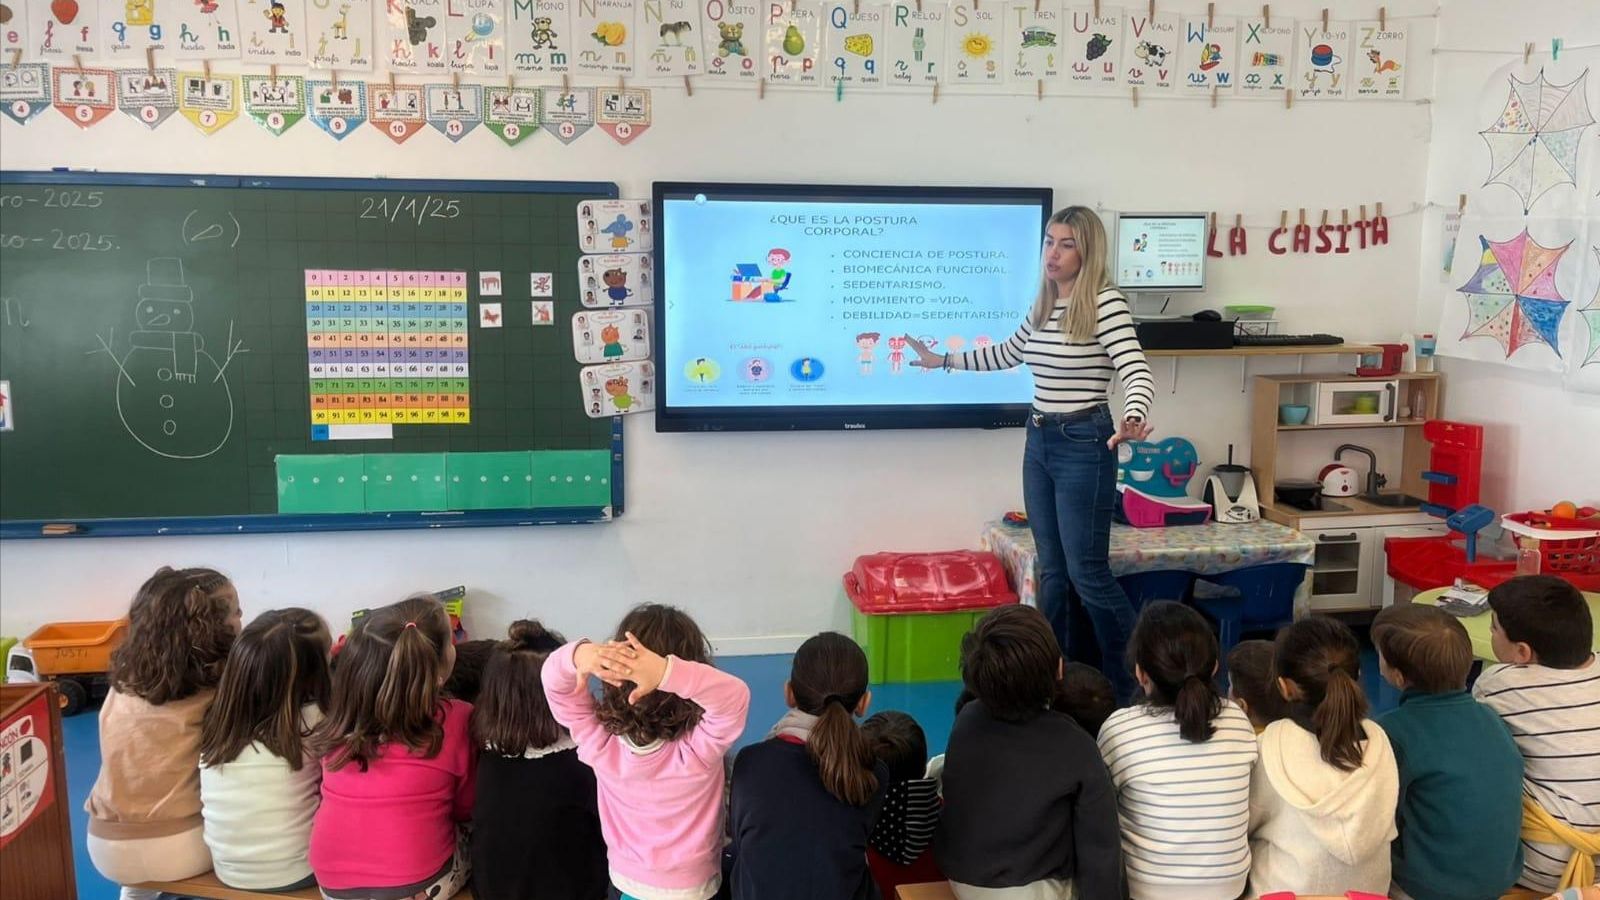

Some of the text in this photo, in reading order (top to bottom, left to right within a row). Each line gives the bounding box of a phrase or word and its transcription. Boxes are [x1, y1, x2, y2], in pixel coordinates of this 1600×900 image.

[448, 0, 494, 16] L LUPA
[514, 0, 564, 20] M MONO
[578, 0, 596, 18] N
[706, 0, 755, 20] O OSITO
[770, 3, 815, 25] P PERA
[831, 6, 880, 29] Q QUESO
[895, 5, 942, 27] R RELOJ
[954, 5, 993, 27] S SOL
[1013, 6, 1056, 28] T TREN
[1073, 12, 1117, 33] U UVAS
[81, 26, 88, 42] f
[149, 24, 161, 40] g
[180, 23, 230, 42] h h
[1131, 17, 1174, 38] V VACA
[1188, 22, 1204, 43] W
[1245, 23, 1261, 44] X
[7, 30, 18, 43] e
[1304, 28, 1317, 48] Y
[1360, 27, 1404, 48] Z ZORRO
[428, 42, 439, 58] k
[514, 53, 566, 64] m m
[615, 52, 626, 64] n
[742, 58, 753, 69] o
[803, 58, 812, 72] p
[864, 59, 875, 74] q
[927, 62, 935, 73] r
[1072, 62, 1113, 73] u u
[1158, 70, 1168, 80] v
[1216, 72, 1230, 83] w
[1273, 74, 1282, 85] x
[1331, 74, 1341, 87] y
[81, 109, 87, 117] 5
[146, 109, 153, 118] 6
[273, 116, 279, 125] 8
[334, 121, 341, 130] 9
[393, 125, 403, 134] 10
[450, 124, 460, 132] 11
[507, 127, 517, 136] 12
[619, 126, 629, 134] 14
[360, 196, 460, 225] 21/1/25
[769, 215, 918, 226] ¿QUE ES LA POSTURA
[804, 227, 884, 236] CORPORAL?
[1206, 227, 1246, 257] LA
[1268, 216, 1388, 255] CASITA
[843, 250, 922, 259] CONCIENCIA
[928, 250, 944, 259] DE
[843, 264, 932, 274] BIOMECÁNICA
[843, 280, 946, 289] SEDENTARISMO.
[843, 296, 925, 305] MOVIMIENTO
